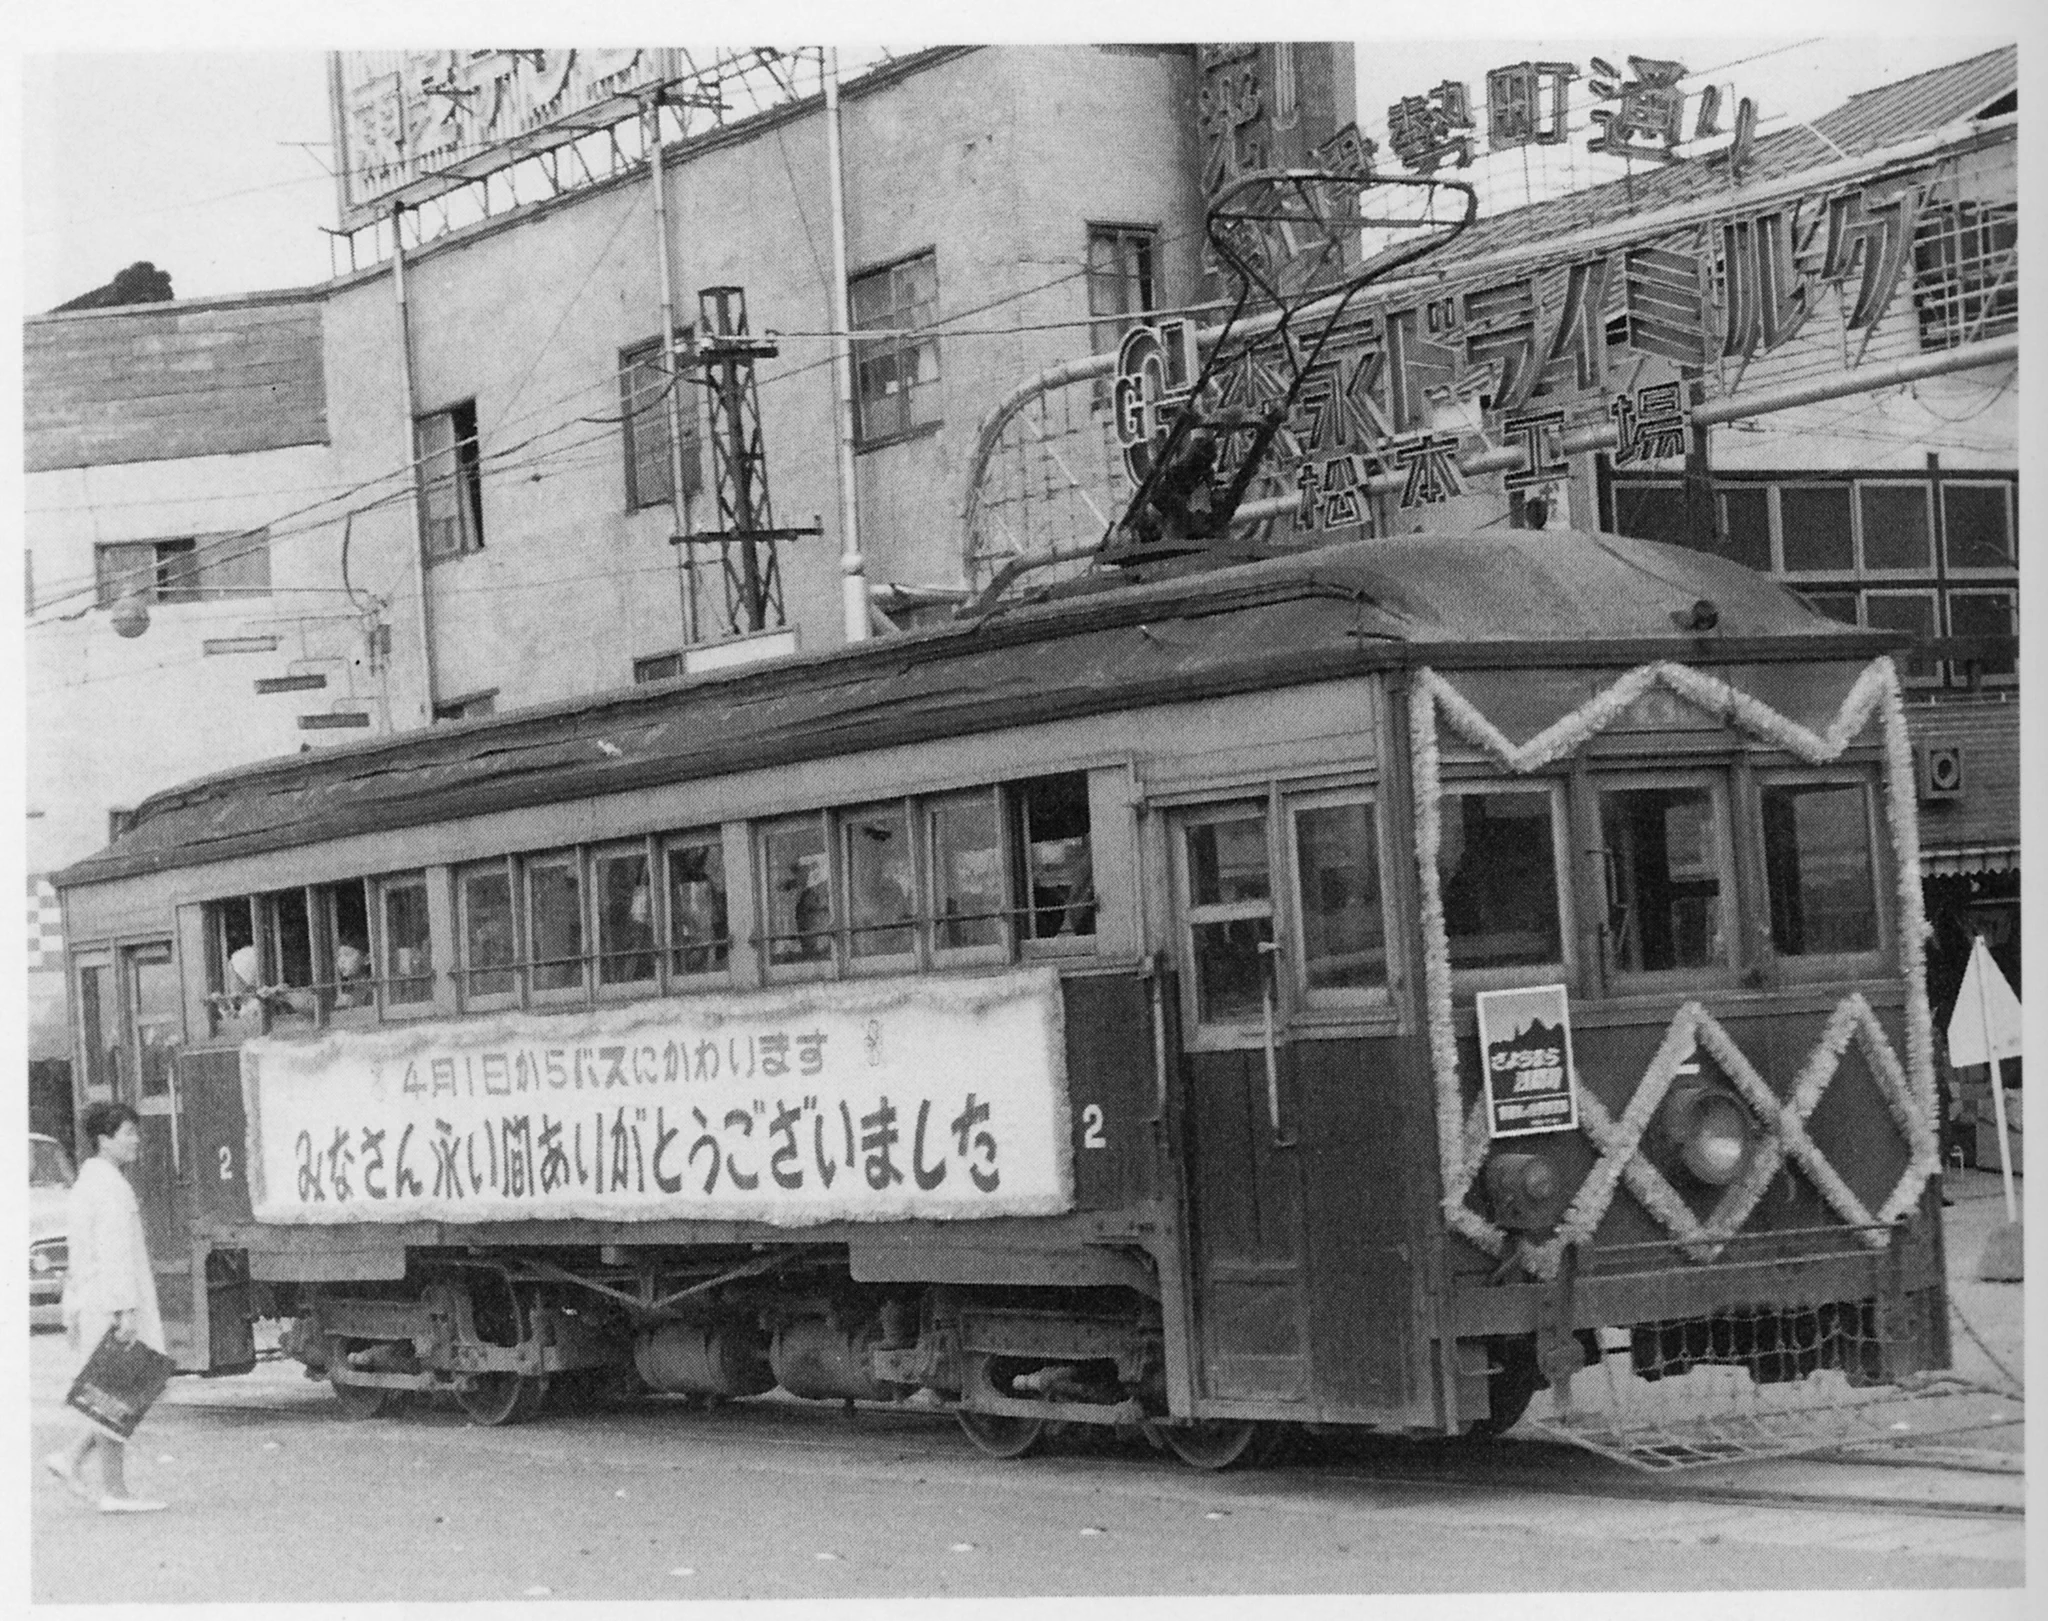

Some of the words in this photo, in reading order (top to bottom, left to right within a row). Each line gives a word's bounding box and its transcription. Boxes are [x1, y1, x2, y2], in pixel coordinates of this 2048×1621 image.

[1297, 380, 1686, 532] 松本工場
[217, 1145, 234, 1181] 2
[294, 1091, 1001, 1203] みなさん永い間ありがとうございました
[1083, 1103, 1107, 1150] 2
